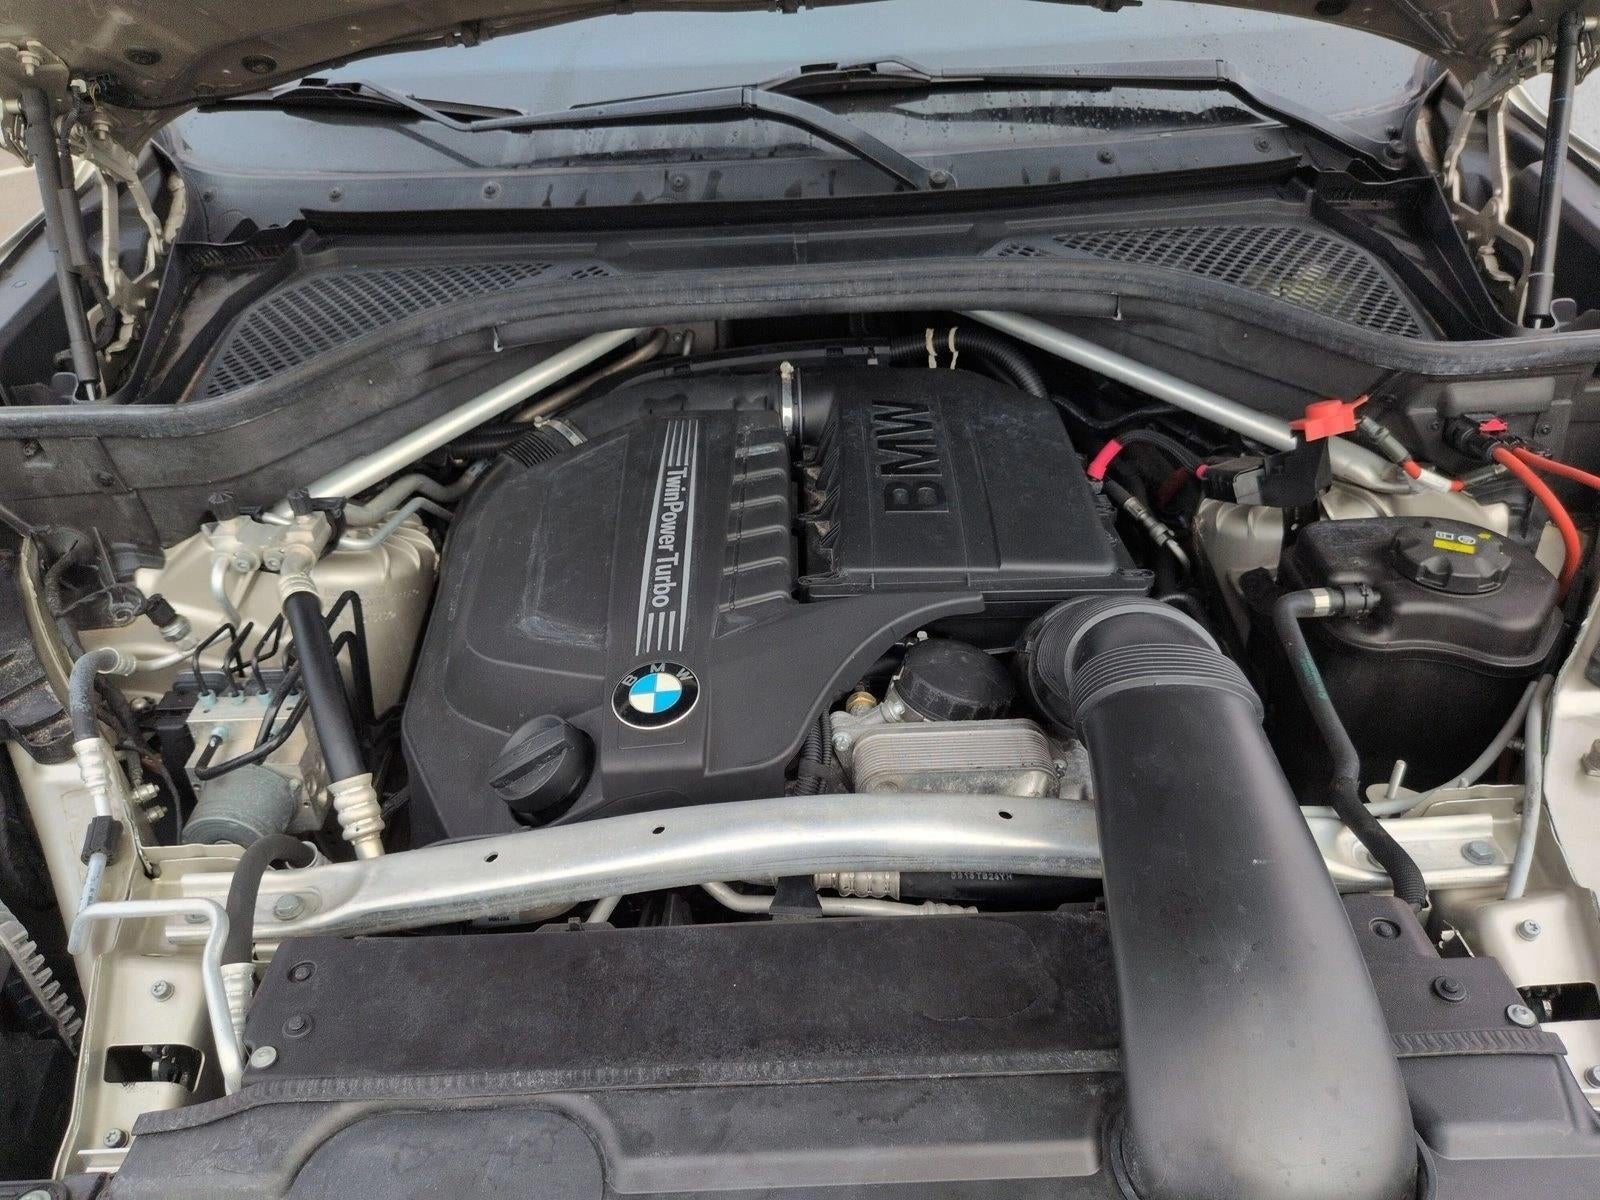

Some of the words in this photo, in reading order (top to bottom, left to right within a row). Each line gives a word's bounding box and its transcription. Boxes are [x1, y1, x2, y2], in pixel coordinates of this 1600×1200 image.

[871, 400, 949, 513] BMW
[658, 466, 688, 551] TwinPower
[651, 552, 680, 608] Turbo
[621, 662, 694, 687] BMW
